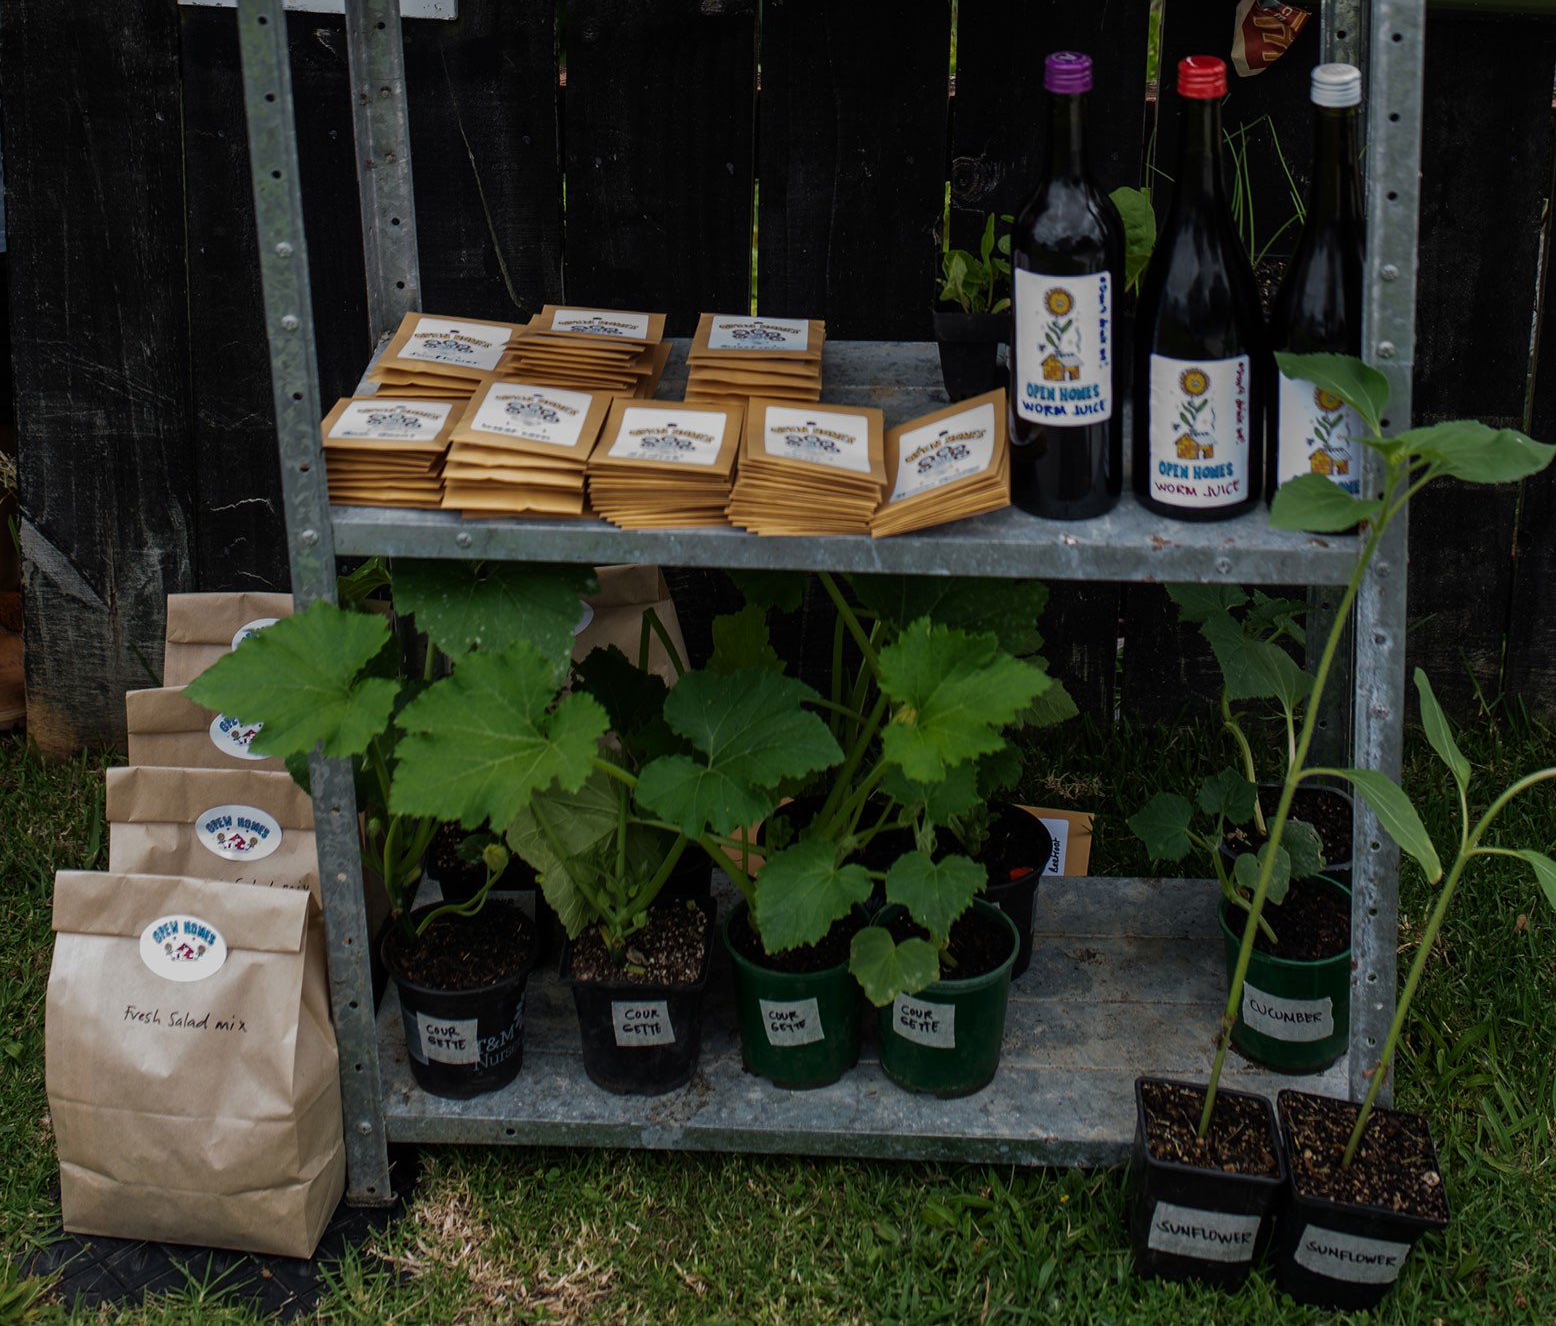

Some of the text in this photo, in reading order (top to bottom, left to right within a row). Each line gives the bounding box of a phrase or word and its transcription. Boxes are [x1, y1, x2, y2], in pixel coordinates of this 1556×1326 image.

[1026, 381, 1099, 402] OPEN HOMES
[1023, 400, 1105, 416] WORM JUICE
[1159, 461, 1234, 480] OPEN HOMES
[1155, 479, 1240, 497] WORM JUICE
[206, 816, 270, 839] OPEN HOMES
[153, 920, 217, 946] OPEN HOMES
[124, 1005, 248, 1033] Fresh Salad mix
[625, 1009, 660, 1020] COUR
[769, 1010, 799, 1022] COUR
[901, 1005, 933, 1020] COUR
[1250, 999, 1322, 1024] CUCUMBER
[426, 1024, 460, 1037] COUR
[622, 1022, 662, 1036] GETTE
[771, 1019, 806, 1033] GETTE
[901, 1016, 940, 1033] GETTE
[428, 1036, 466, 1050] GETTE
[1156, 1219, 1252, 1245] SUNFLOWER
[1306, 1241, 1396, 1267] SUNFLOWER
